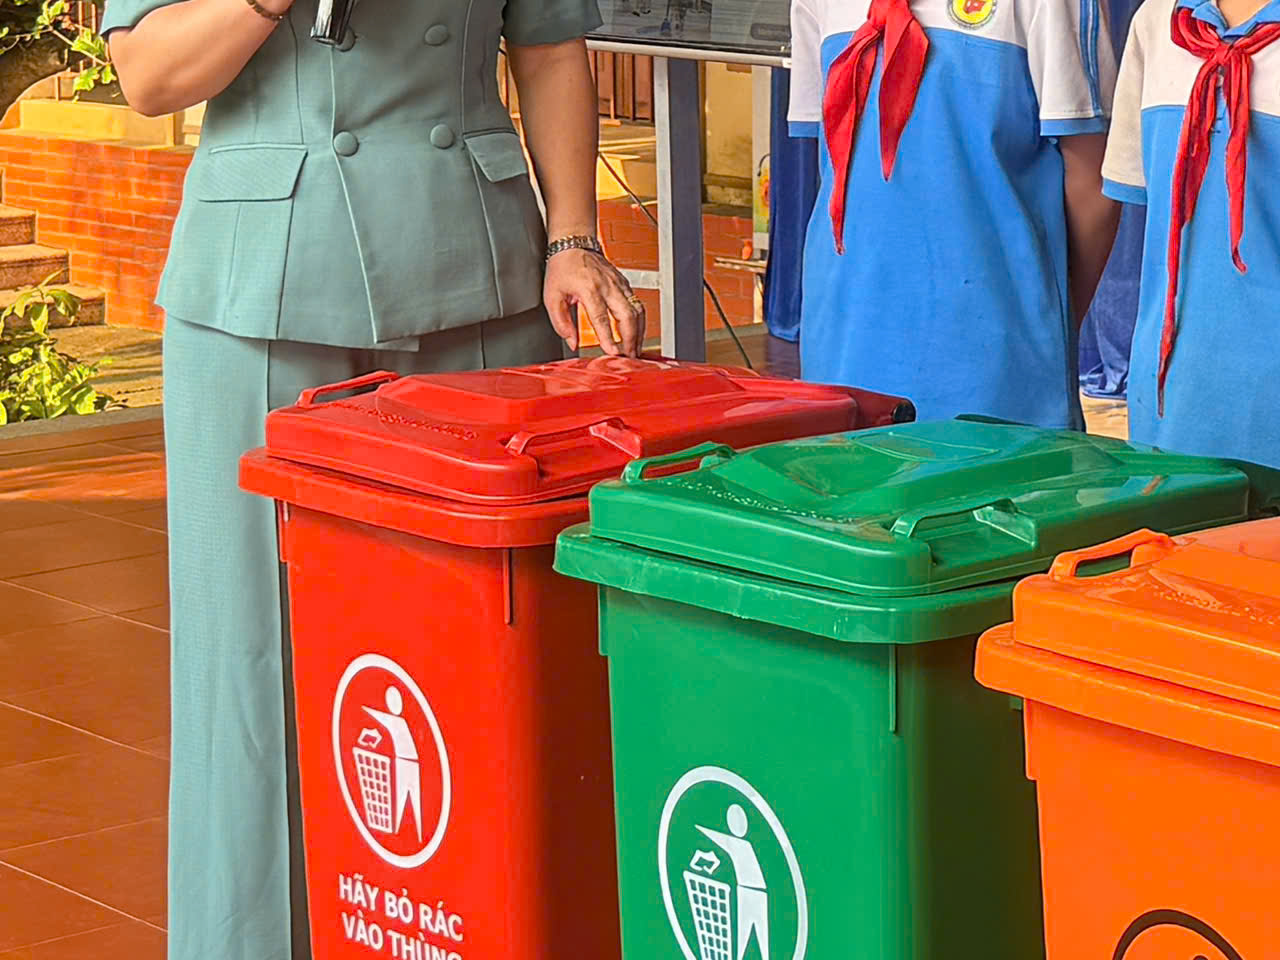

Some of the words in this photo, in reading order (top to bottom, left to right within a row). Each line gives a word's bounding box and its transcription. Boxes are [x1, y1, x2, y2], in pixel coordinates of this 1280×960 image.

[338, 872, 380, 912] HÃY
[384, 887, 414, 924] BỎ
[419, 900, 464, 942] RÁC
[341, 908, 385, 951] VÀO
